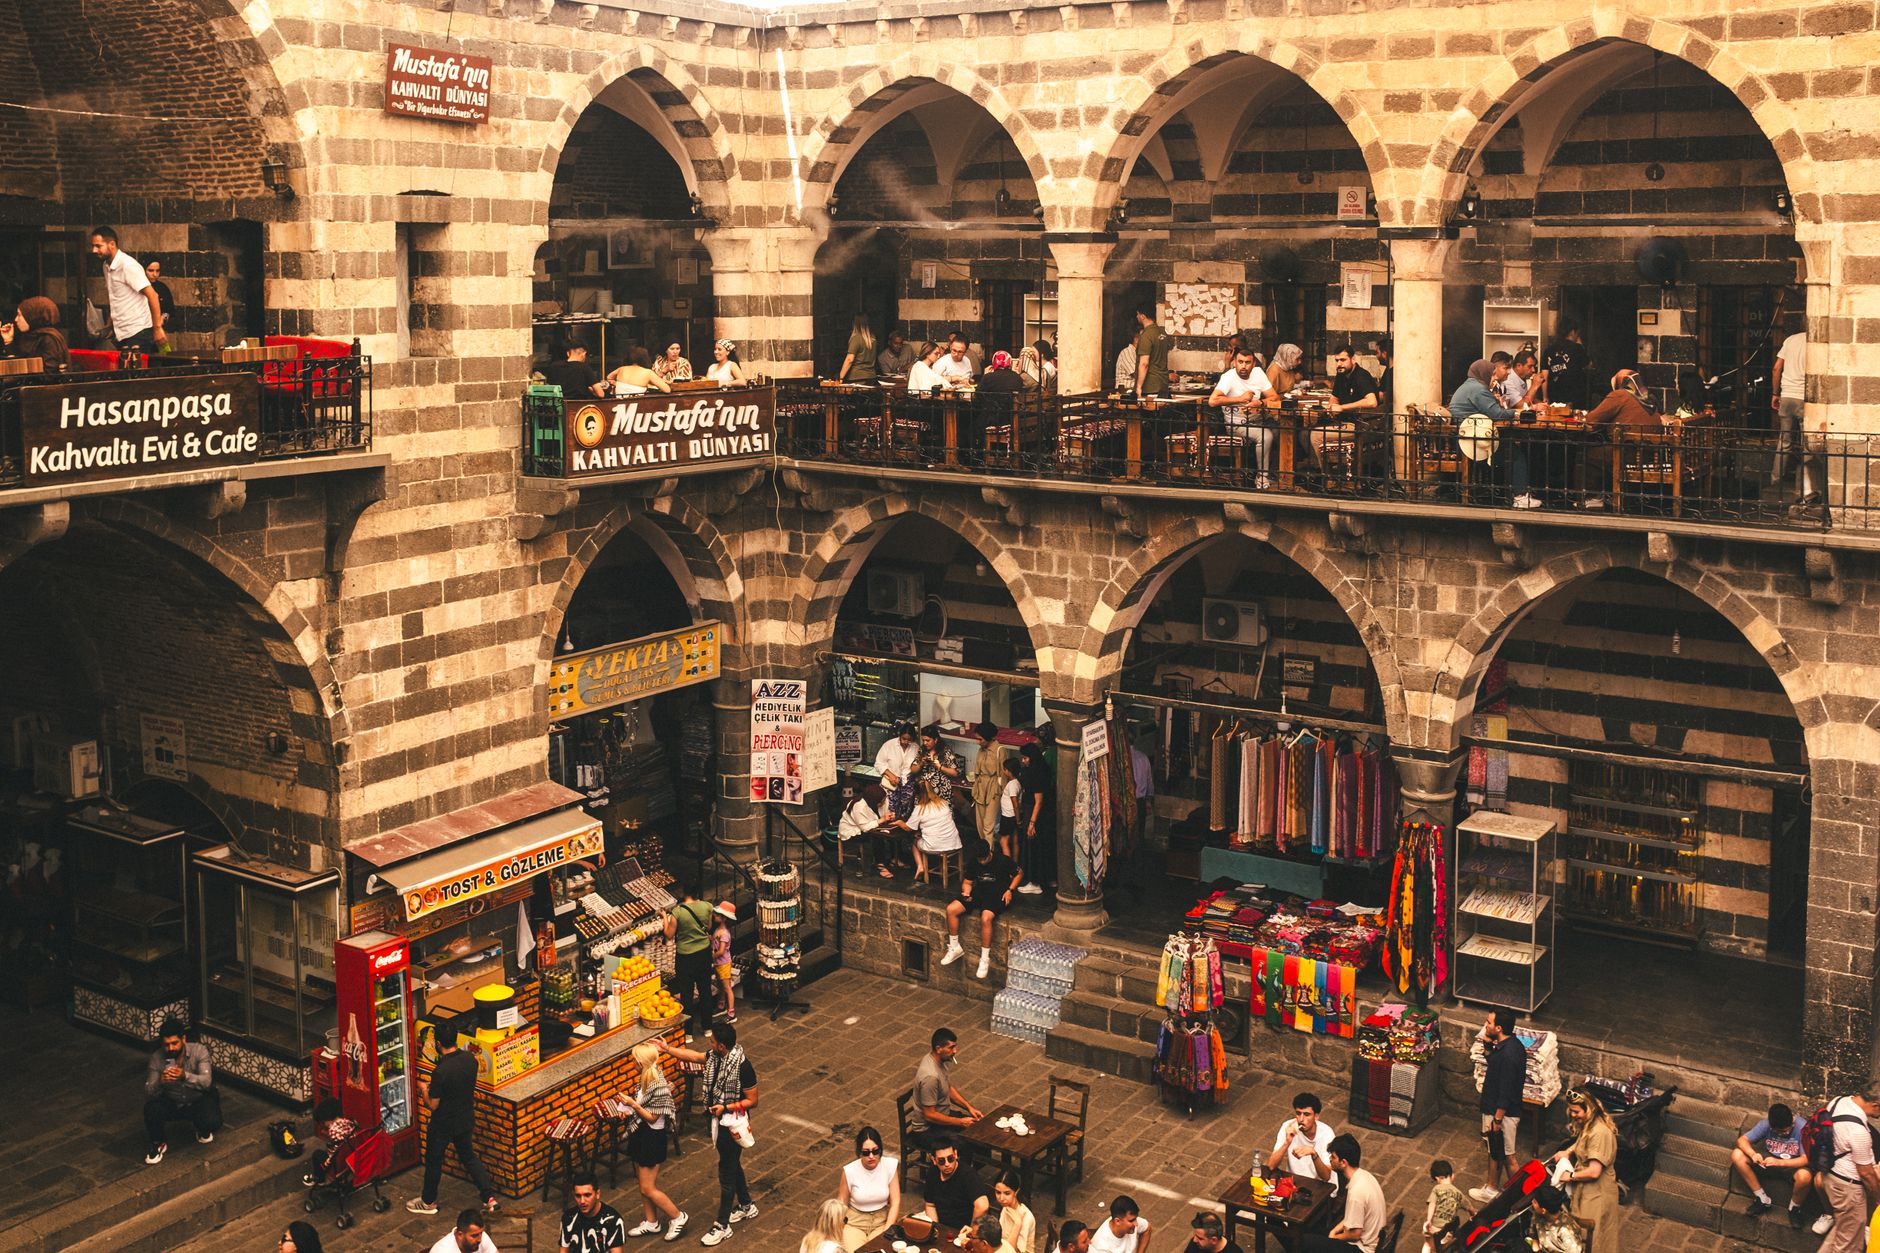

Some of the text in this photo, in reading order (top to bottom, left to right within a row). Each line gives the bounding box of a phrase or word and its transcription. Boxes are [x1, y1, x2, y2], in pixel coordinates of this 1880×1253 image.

[393, 48, 489, 90] Mustafa'nın
[391, 80, 488, 107] KAHVALTI DÜNYASI
[60, 392, 232, 429] Hasanpaşa
[610, 399, 760, 436] Mustafa'nın
[30, 426, 258, 474] Kahvaltı Evi & Cafe
[572, 433, 770, 471] KAHVALTI DÜNYASI
[592, 640, 669, 680] YEKTA
[756, 682, 801, 699] AZZ
[775, 724, 780, 732] &
[783, 714, 803, 723] TAKI
[441, 875, 480, 901] TOST
[484, 870, 496, 886] &
[500, 845, 565, 881] GÖZLEME
